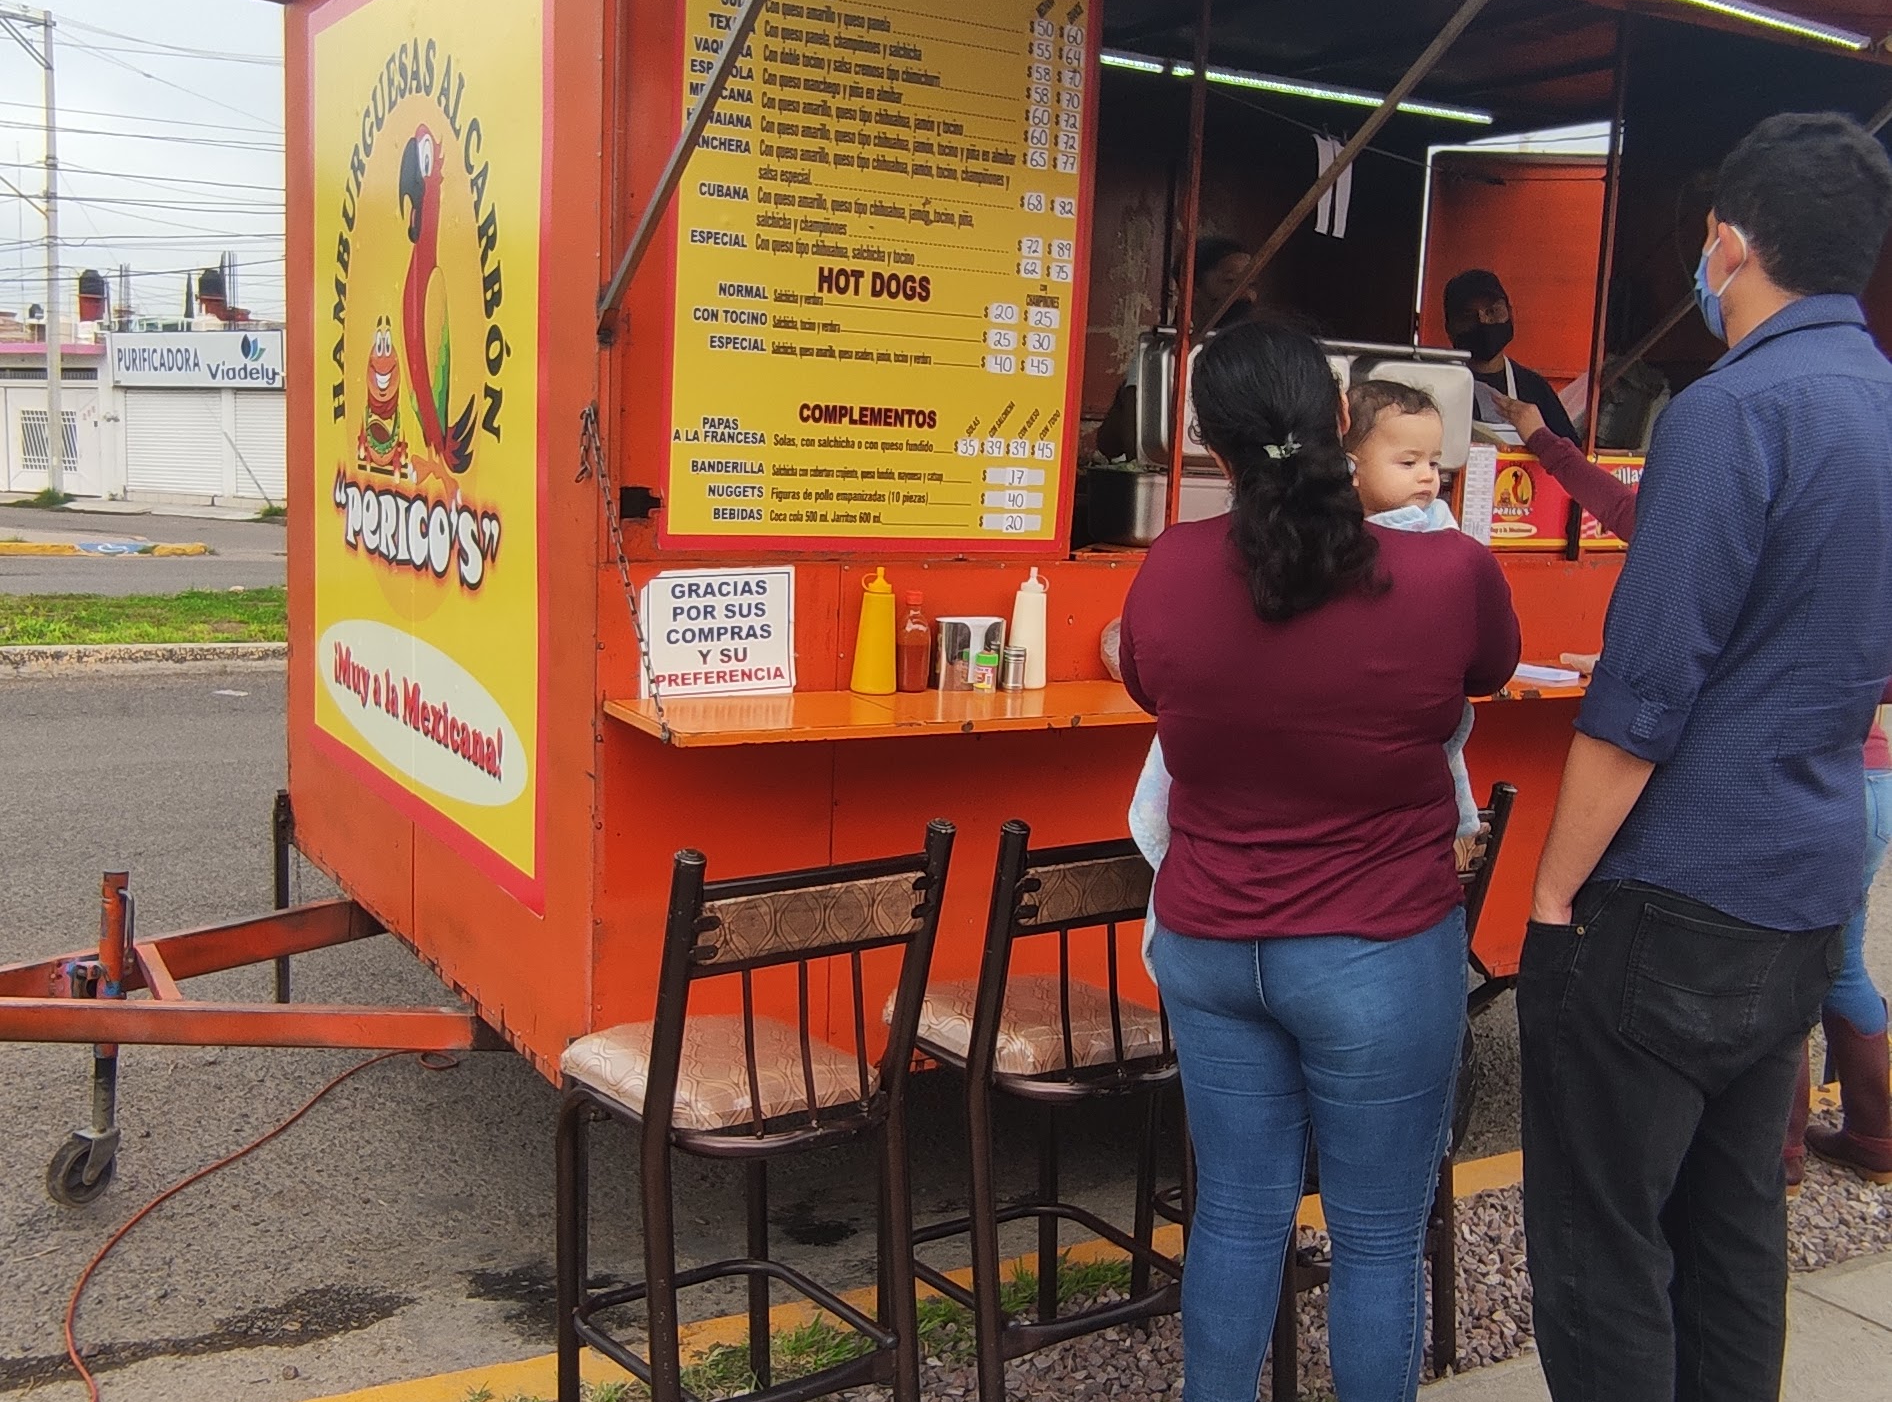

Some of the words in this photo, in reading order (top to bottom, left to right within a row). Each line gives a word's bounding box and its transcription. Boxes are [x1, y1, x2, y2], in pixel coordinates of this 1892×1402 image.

[690, 59, 754, 81] ESPOLA
[690, 82, 753, 103] MCANA
[698, 135, 751, 154] NCHERA
[700, 183, 749, 201] CUBANA
[333, 37, 436, 424] HAMBURGUESAS
[437, 54, 465, 141] AL
[464, 117, 512, 444] CARBÓN
[690, 230, 747, 248] ESPECIAL
[718, 283, 768, 299] NORMAL
[818, 267, 864, 296] HOT
[871, 272, 931, 302] DOGS
[694, 308, 718, 323] CON
[722, 310, 768, 326] TOCINO
[710, 335, 766, 352] ESPECIAL
[117, 347, 201, 372] PURIFICADORA
[206, 361, 280, 385] Viadely
[702, 417, 738, 430] PAPAS
[799, 403, 937, 429] COMPLEMENTOS
[673, 429, 681, 441] A
[685, 431, 699, 442] LA
[704, 431, 766, 445] FRANCESA
[801, 438, 815, 447] con
[818, 437, 855, 449] salchicha
[865, 440, 878, 450] con
[881, 441, 903, 453] queso
[692, 460, 764, 474] BANDERILLA
[708, 485, 764, 497] NUGGETS
[803, 488, 812, 500] de
[713, 508, 762, 520] BEBIDAS
[671, 580, 767, 599] GRACIAS
[672, 605, 717, 622] POR
[724, 602, 766, 619] SUS
[666, 624, 772, 644] COMPRAS
[698, 649, 712, 665] Y
[720, 647, 748, 663] SU
[655, 667, 785, 687] PREFERENCIA
[334, 641, 370, 709] ¡Muy
[373, 673, 382, 708] a
[385, 668, 399, 721] la
[403, 676, 504, 782] Mexicana!
